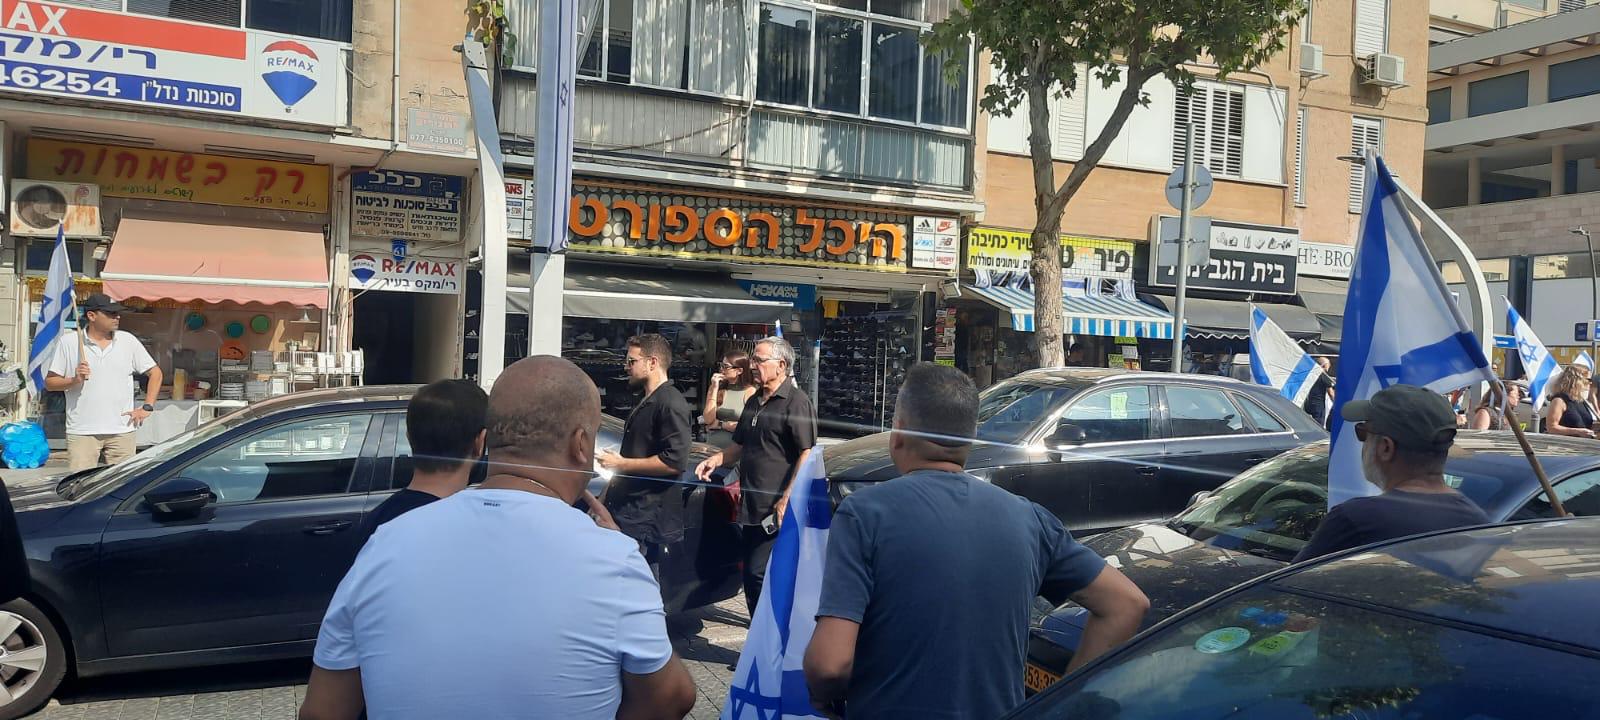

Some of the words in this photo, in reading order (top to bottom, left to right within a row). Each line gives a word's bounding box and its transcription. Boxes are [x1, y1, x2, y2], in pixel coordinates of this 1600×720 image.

[0, 1, 67, 36] AX
[267, 57, 314, 73] RE/MAX
[141, 80, 179, 101] נדל"ן
[186, 88, 235, 107] סוכנות
[54, 147, 228, 187] בשמחות
[255, 166, 305, 197] רק
[368, 169, 422, 188] כלל
[505, 183, 523, 195] ANS
[355, 195, 389, 207] לביטוח
[393, 199, 425, 210] סוכנות
[568, 196, 780, 250] הספורט
[796, 208, 907, 259] היכל
[971, 232, 1008, 249] כתיבה
[393, 248, 406, 257] 61
[1297, 247, 1318, 265] HE
[382, 258, 456, 277] RE/MAX
[996, 257, 1020, 269] עיתונים
[1250, 261, 1285, 284] בית
[384, 277, 410, 288] בעיר
[415, 278, 457, 290] רי/מקס
[749, 284, 785, 298] HOKA
